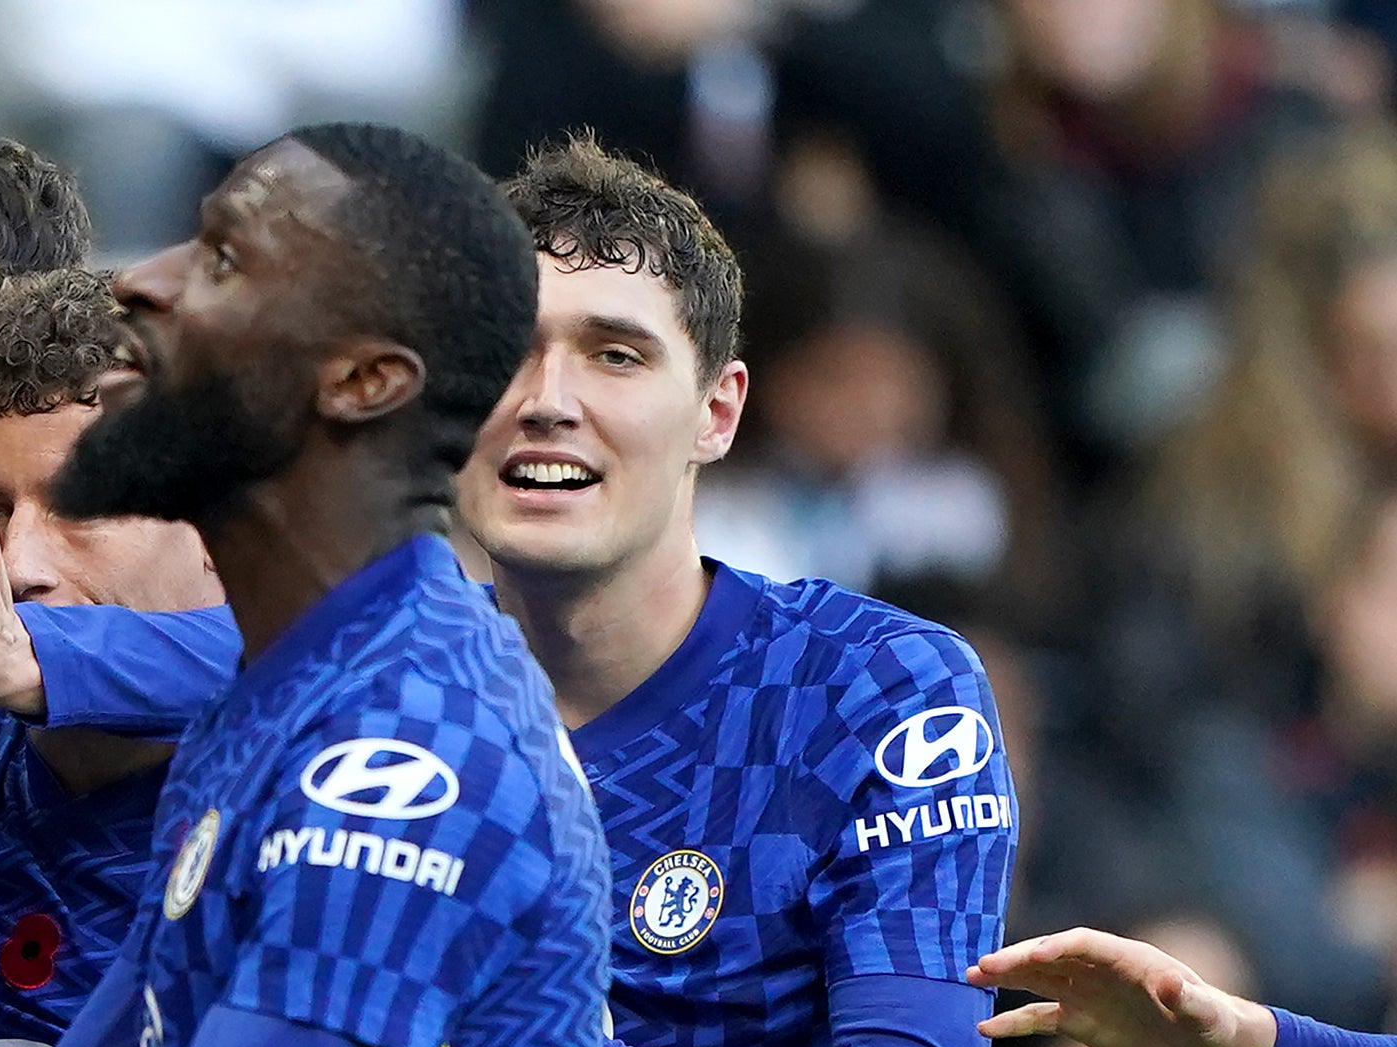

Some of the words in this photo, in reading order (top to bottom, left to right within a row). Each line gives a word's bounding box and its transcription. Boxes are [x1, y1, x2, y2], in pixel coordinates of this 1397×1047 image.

[257, 826, 465, 897] HYUNDAI
[653, 854, 713, 878] CHELSEA
[640, 927, 677, 948] FOOTBALL
[679, 928, 700, 946] CLUB
